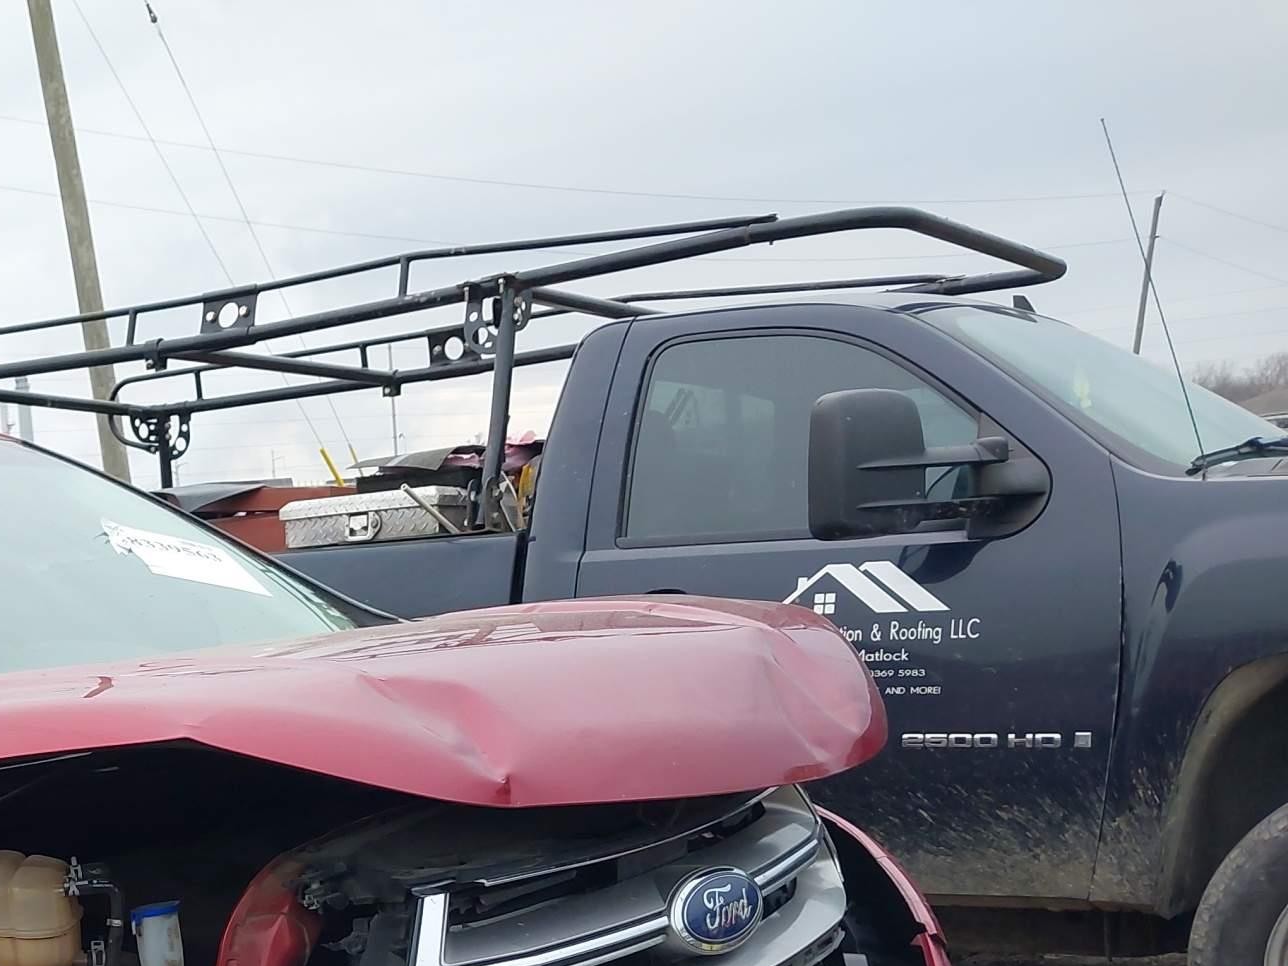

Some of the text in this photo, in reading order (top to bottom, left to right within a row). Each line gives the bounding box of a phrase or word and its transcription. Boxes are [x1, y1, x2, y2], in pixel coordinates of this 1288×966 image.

[870, 623, 882, 642] &
[889, 620, 943, 644] Roofing
[950, 617, 981, 639] LLC
[897, 668, 926, 677] 5983
[885, 686, 906, 695] AND
[901, 732, 1062, 748] 2500 HD
[703, 883, 753, 929] Ford
